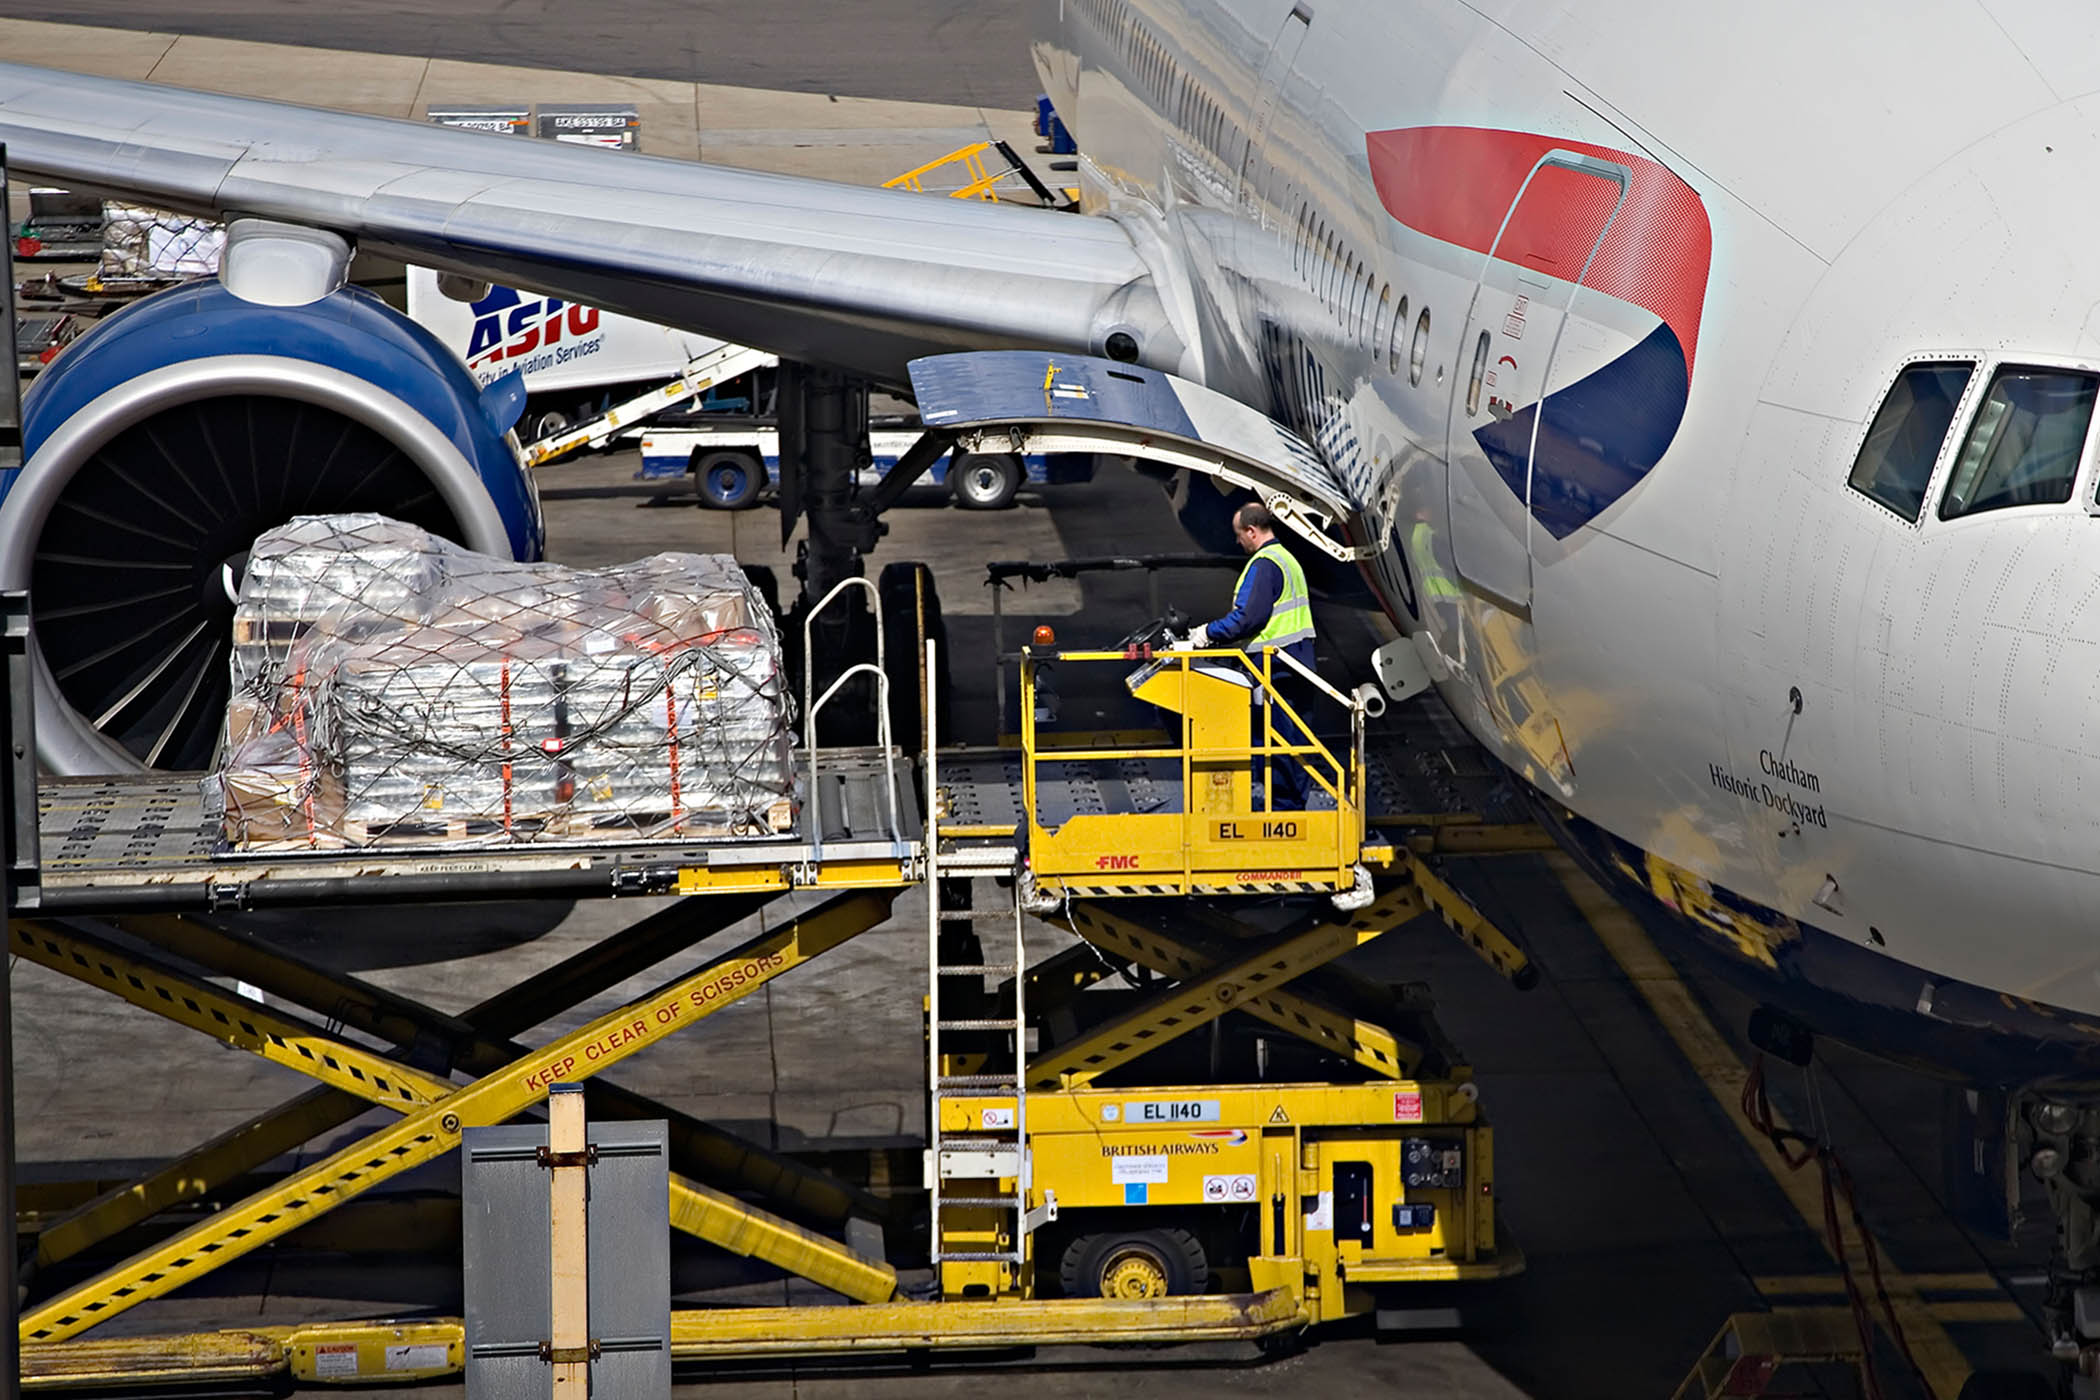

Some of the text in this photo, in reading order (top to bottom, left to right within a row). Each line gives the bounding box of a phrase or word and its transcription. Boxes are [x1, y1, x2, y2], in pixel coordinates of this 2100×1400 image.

[556, 338, 600, 365] Services
[1760, 749, 1820, 793] Chatham
[1709, 763, 1828, 828] Historic Dockyard
[1219, 822, 1297, 839] EL 1140
[1096, 855, 1139, 870] FMC
[1235, 872, 1302, 882] COMMANDER
[526, 951, 784, 1092] KEEP CLEAR OF SCISSORS
[1144, 1103, 1201, 1120] EL 1140
[1101, 1142, 1219, 1158] BRITISH AIRWAYS
